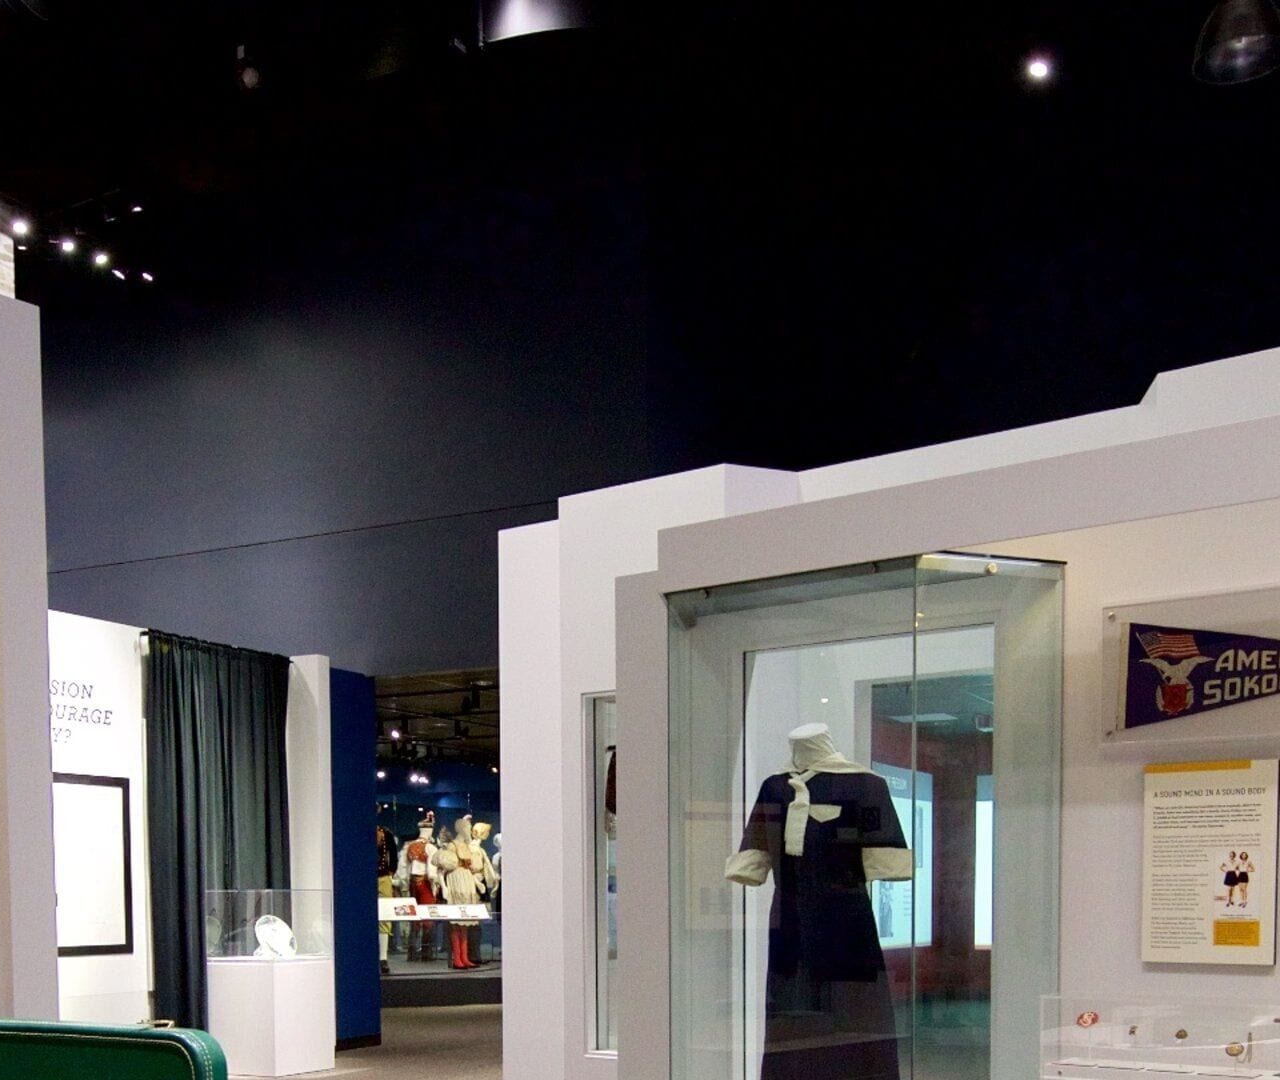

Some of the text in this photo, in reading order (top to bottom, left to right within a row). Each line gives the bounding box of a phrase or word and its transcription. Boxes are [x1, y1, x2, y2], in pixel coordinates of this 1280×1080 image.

[49, 679, 94, 699] SION
[49, 703, 113, 726] URAGE
[1160, 790, 1182, 798] SOUND
[1184, 789, 1203, 797] MIND
[1205, 789, 1214, 797] IN
[1215, 788, 1221, 796] A
[1222, 787, 1246, 796] SOUND
[1247, 787, 1266, 795] BODY
